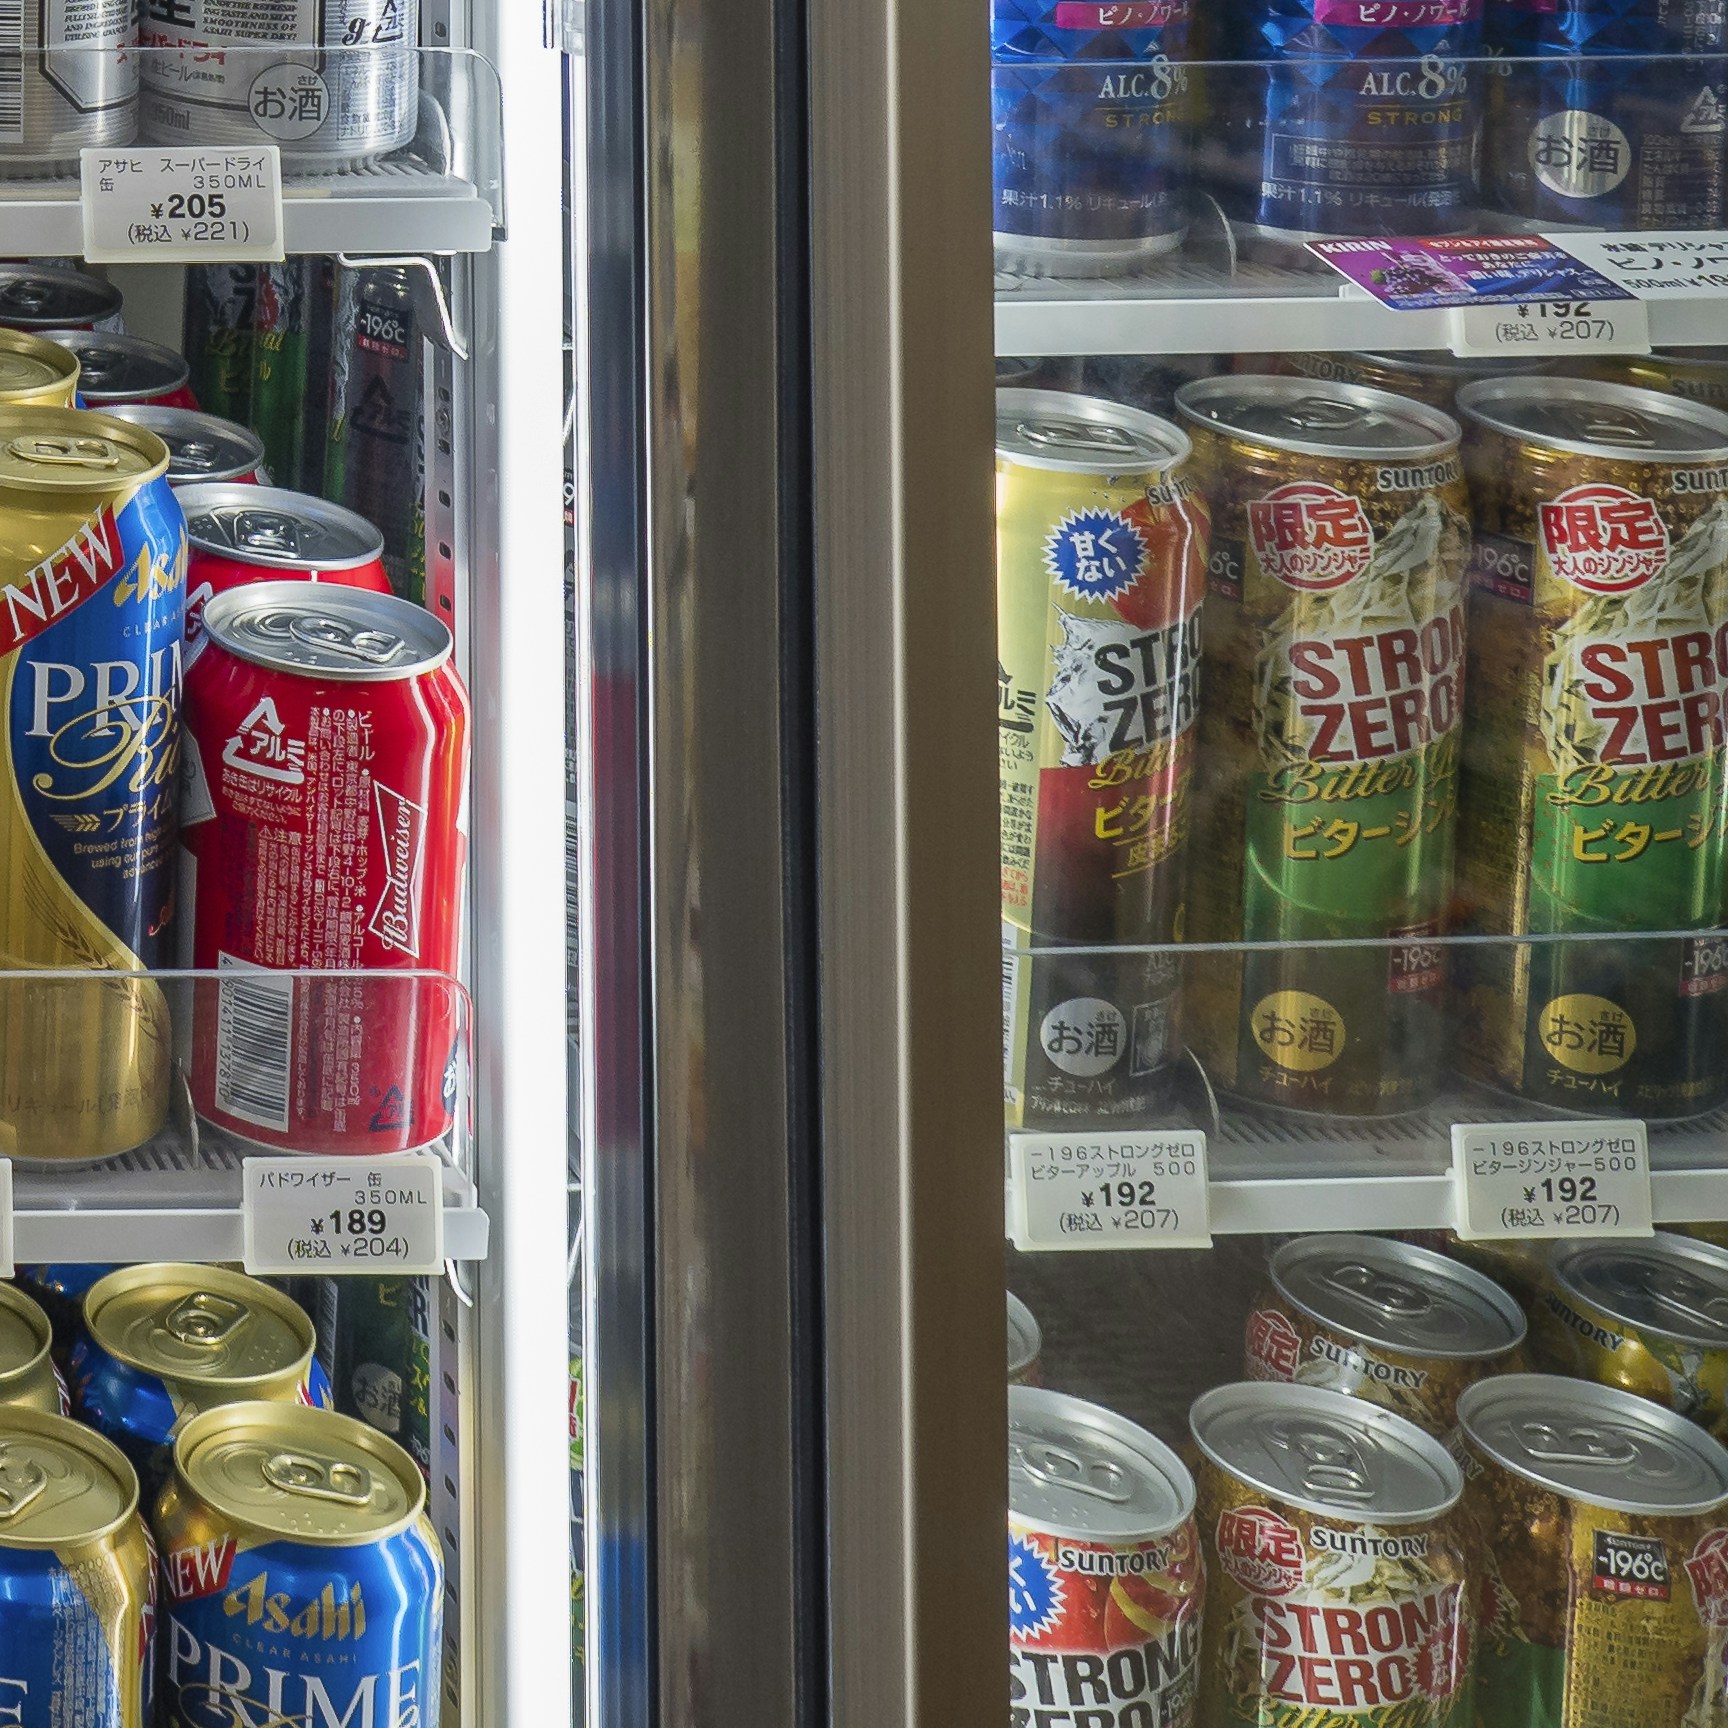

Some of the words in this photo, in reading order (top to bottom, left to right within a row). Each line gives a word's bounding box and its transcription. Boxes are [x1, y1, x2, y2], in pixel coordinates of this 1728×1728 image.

[254, 86, 324, 124] お酒
[1366, 108, 1464, 126] STRONG
[1534, 132, 1621, 176] お酒
[150, 193, 227, 220] ¥205
[1495, 322, 1539, 343] (税込
[1546, 319, 1615, 343] ¥207)
[1256, 502, 1374, 554] 限定
[1544, 502, 1664, 550] 限定
[2, 512, 120, 642] NEW
[382, 797, 416, 952] Budweiser
[1046, 1018, 1118, 1058] お酒
[1260, 1016, 1336, 1058] お酒
[1548, 1016, 1626, 1058] お酒
[1031, 1161, 1137, 1181] ビターアップル
[1153, 1160, 1196, 1177] 500
[1522, 1175, 1598, 1204] ¥192
[1080, 1180, 1157, 1208] ¥192
[310, 1208, 387, 1236] ¥189
[1060, 1546, 1170, 1574] SUNTORY
[1310, 1526, 1430, 1560] SUNTORY
[222, 1570, 368, 1642] Asahi
[1264, 1652, 1412, 1706] ZERO
